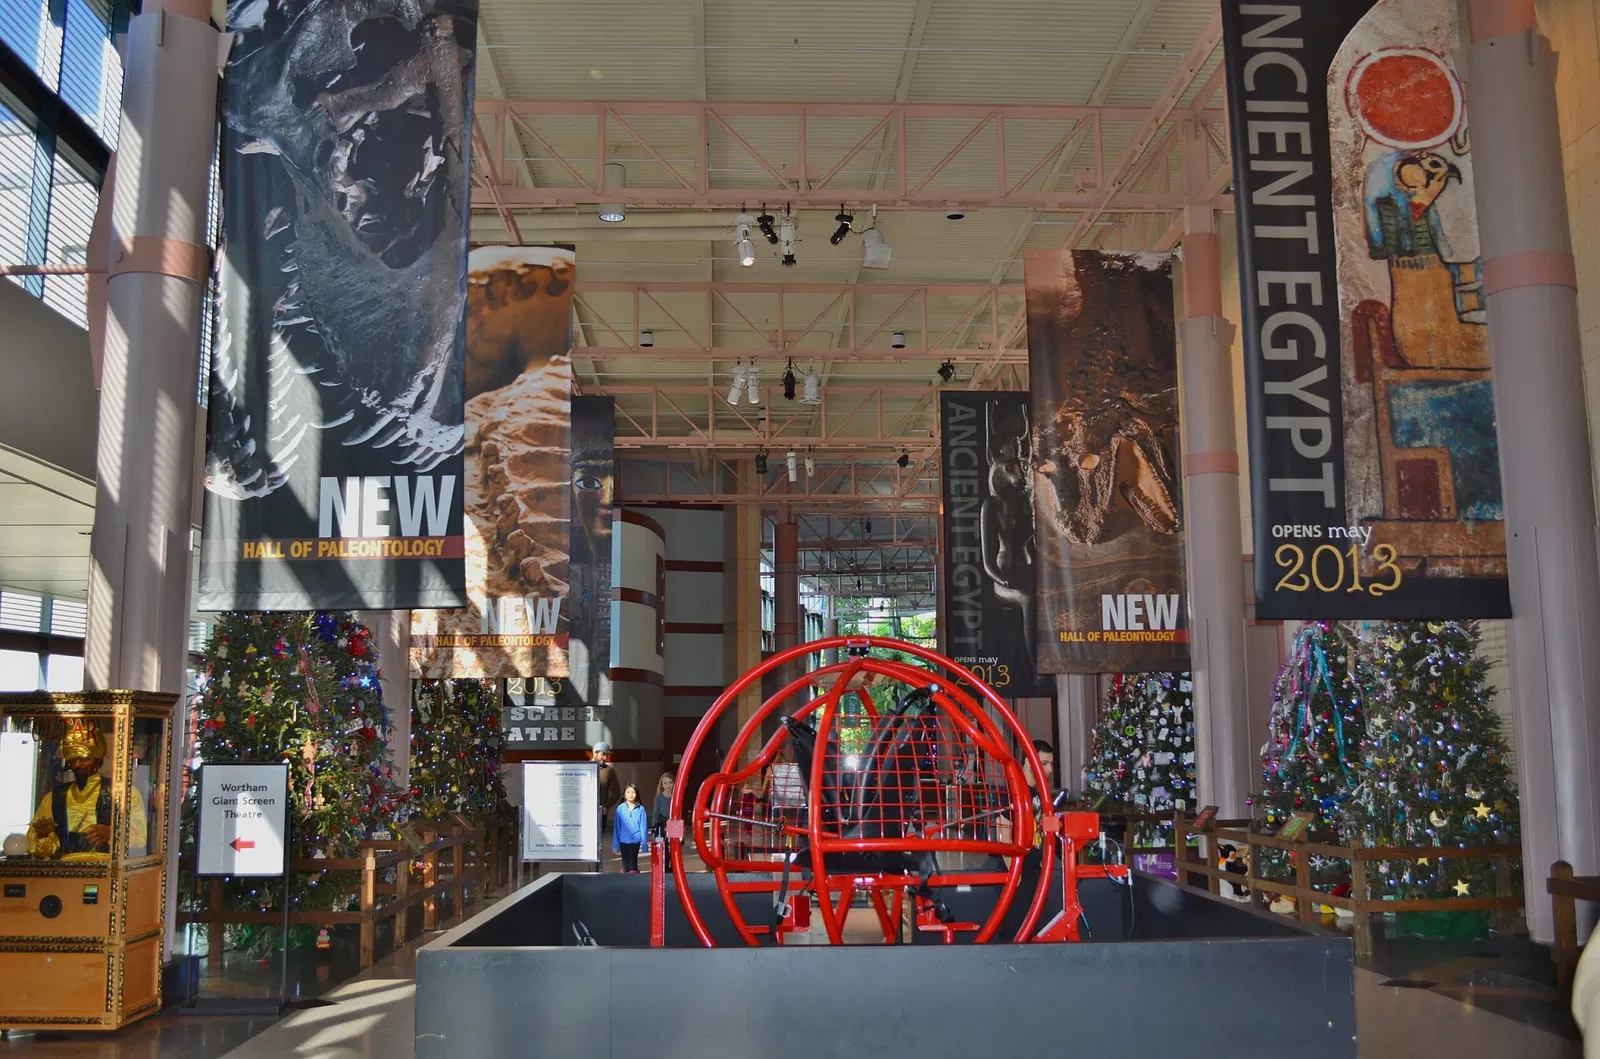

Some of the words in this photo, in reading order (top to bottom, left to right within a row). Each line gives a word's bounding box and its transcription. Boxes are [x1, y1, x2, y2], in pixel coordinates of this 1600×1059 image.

[1257, 270, 1336, 508] EGYPT
[947, 401, 980, 540] ANCIENT
[319, 475, 456, 538] NEW
[1272, 525, 1322, 538] OPENS
[1328, 526, 1372, 546] may
[243, 542, 285, 558] HALL
[290, 541, 313, 558] OF
[318, 540, 445, 558] PALEONTOLOGY
[1274, 543, 1402, 596] 2013
[952, 546, 983, 650] EGYPT
[481, 597, 562, 635] NEW
[1101, 594, 1179, 631] NEW
[435, 635, 461, 647] HALL
[464, 635, 477, 647] OF
[480, 635, 556, 647] PALEONTOLOGY
[1060, 632, 1085, 642] HALL
[1087, 632, 1100, 642] OF
[1103, 632, 1175, 641] PALEONTOLOGY
[978, 656, 998, 666] may
[507, 677, 562, 697] 2013
[221, 783, 268, 792] Wortham
[212, 797, 239, 805] Giant
[242, 797, 275, 805] Screen
[224, 810, 262, 818] Theatre
